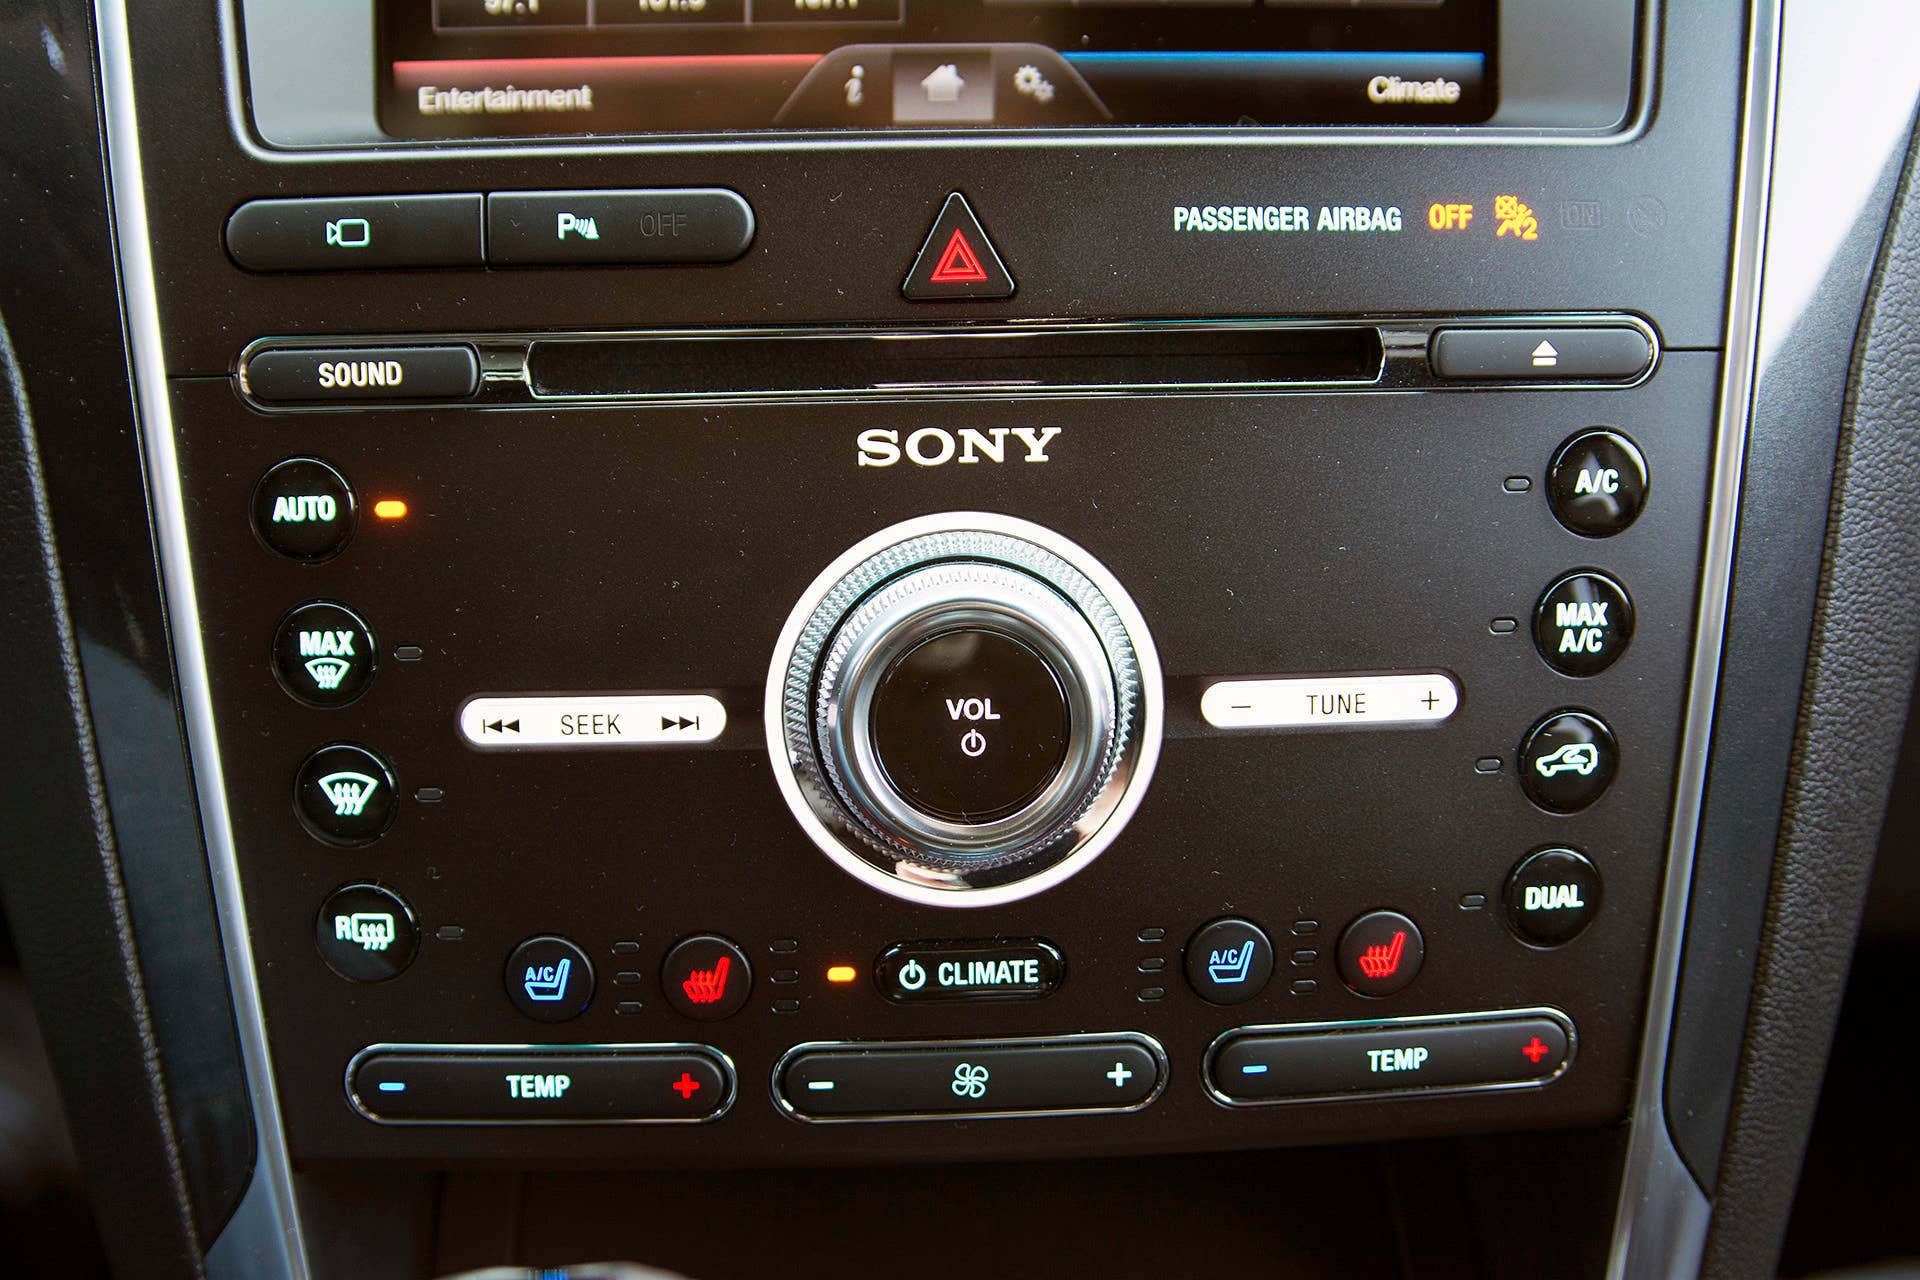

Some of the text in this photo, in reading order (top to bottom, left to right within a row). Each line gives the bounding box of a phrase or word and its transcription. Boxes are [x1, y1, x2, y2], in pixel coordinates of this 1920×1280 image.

[418, 84, 592, 113] Entertainment
[1367, 75, 1461, 103] Climate
[640, 212, 687, 237] OFF
[1173, 205, 1403, 232] PASSENGER AIRBAG
[1428, 203, 1474, 231] OFF
[317, 360, 403, 388] SOUND
[856, 426, 1062, 468] SONY
[1574, 468, 1619, 495] A/C
[272, 494, 337, 523] AUTO
[1556, 602, 1608, 627] MAX
[299, 630, 356, 656] MAX
[1558, 628, 1603, 654] A/C
[945, 698, 1001, 721] VOL
[1306, 693, 1366, 715] TUNE
[560, 714, 621, 736] SEEK
[1524, 884, 1585, 911] DUAL
[1209, 949, 1238, 965] A/C
[525, 966, 554, 982] A/C
[937, 958, 1040, 986] CLIMATE
[1366, 1046, 1429, 1073] TEMP
[505, 1074, 571, 1099] TEMP
